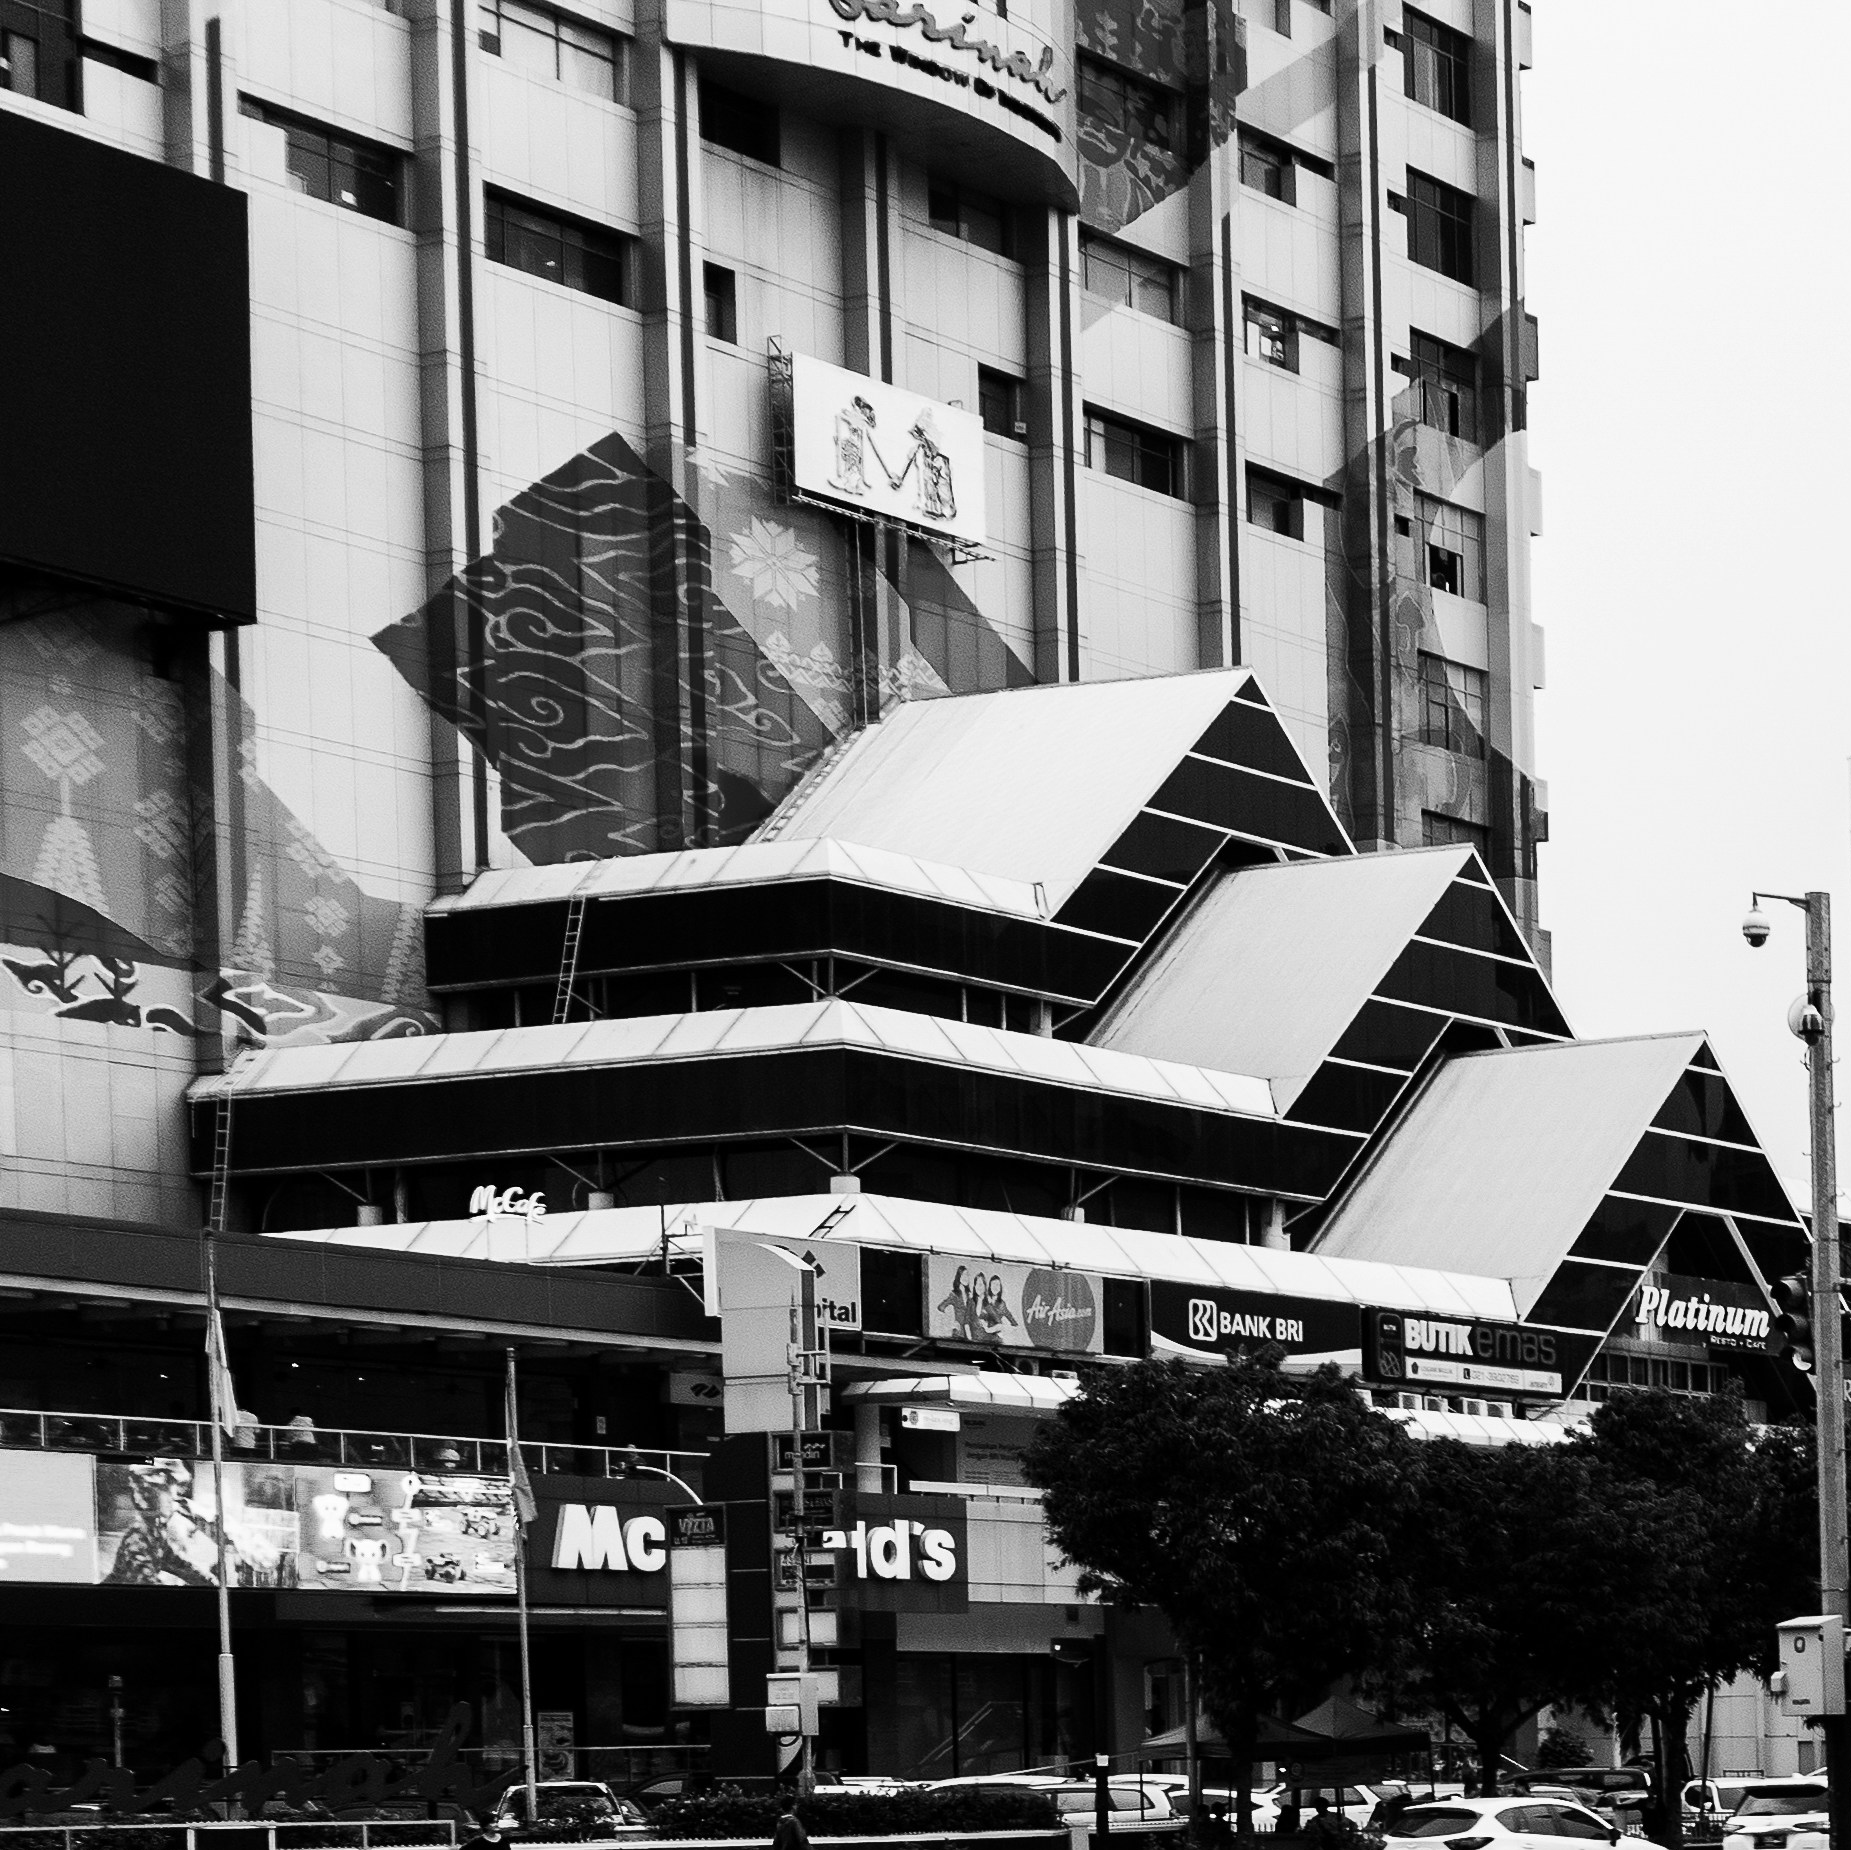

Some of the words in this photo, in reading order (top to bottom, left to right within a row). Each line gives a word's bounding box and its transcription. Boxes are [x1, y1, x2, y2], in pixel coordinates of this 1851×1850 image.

[838, 30, 881, 58] THE
[1219, 1310, 1271, 1340] BANK
[1276, 1319, 1304, 1343] BRI
[1635, 1286, 1770, 1338] Platinum
[1404, 1317, 1473, 1356] BUTIK
[1474, 1326, 1557, 1366] emas
[0, 1701, 528, 1815] arinah
